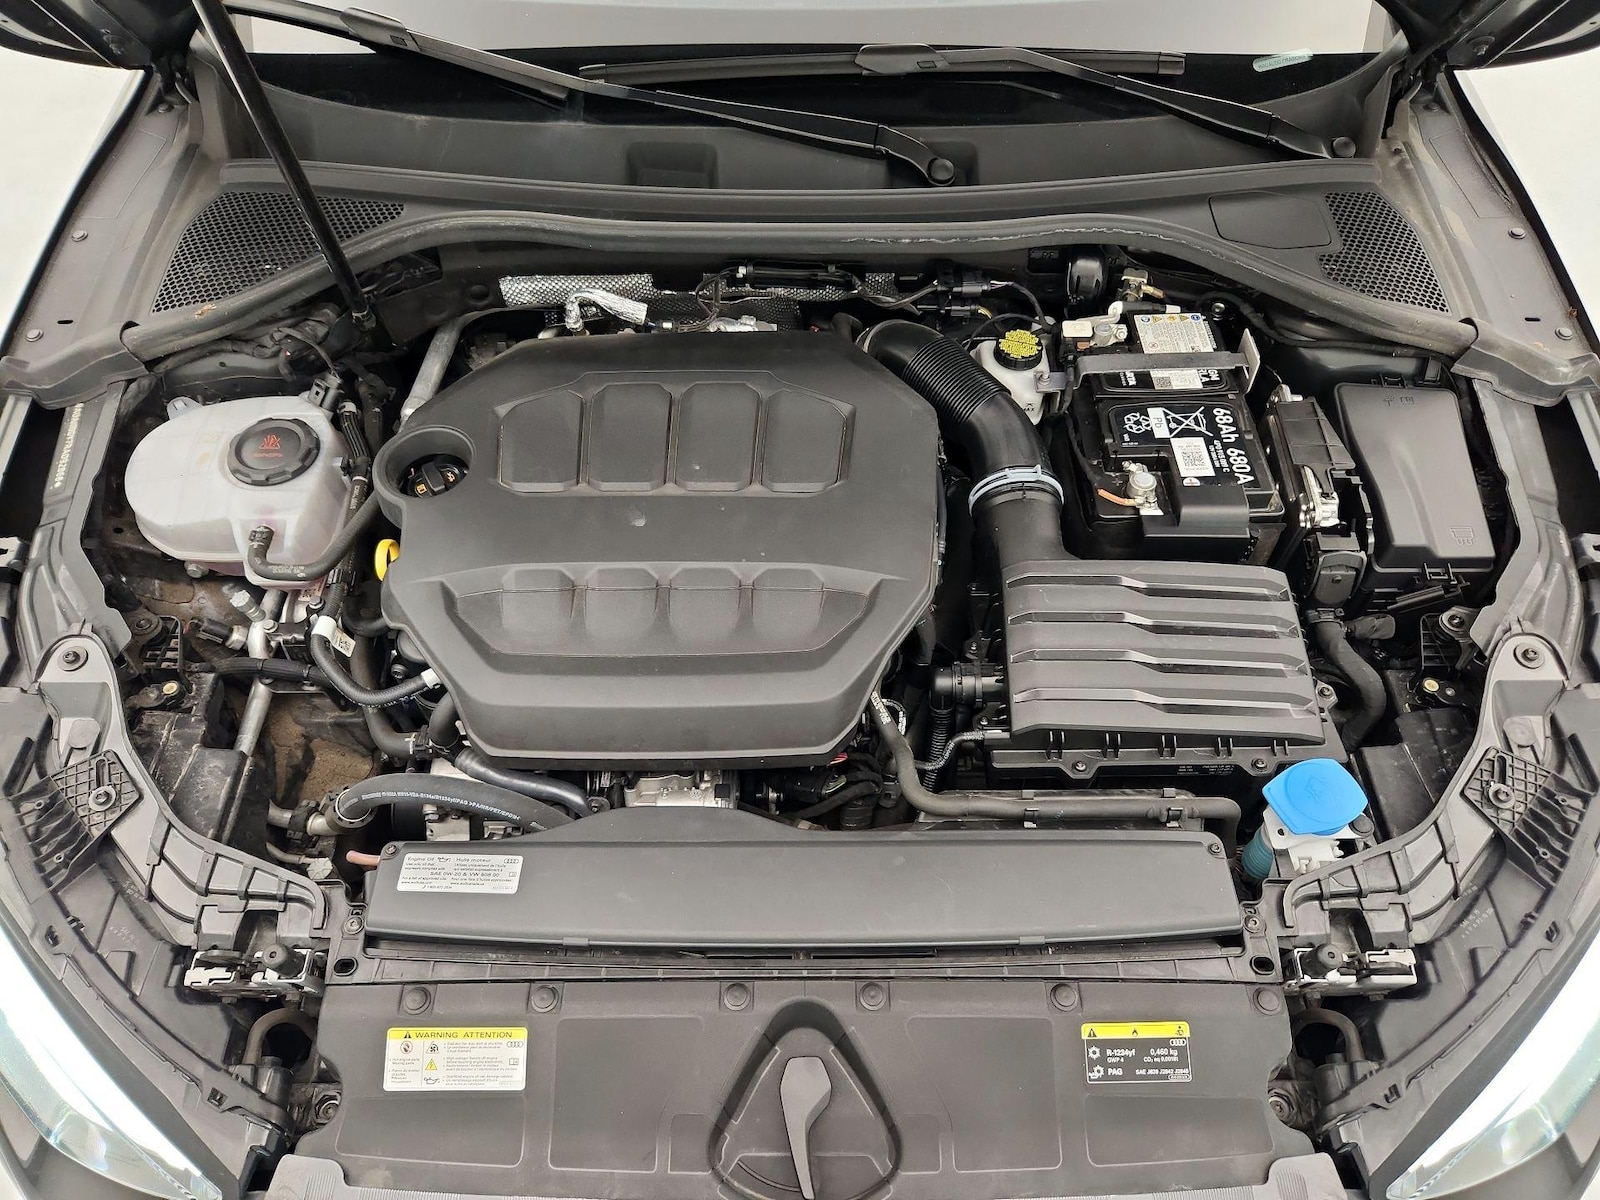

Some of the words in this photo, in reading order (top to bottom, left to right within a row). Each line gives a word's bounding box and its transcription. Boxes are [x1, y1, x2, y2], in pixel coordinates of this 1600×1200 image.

[1152, 417, 1164, 429] Pb
[1212, 407, 1239, 443] 68Ah
[1226, 447, 1255, 485] 680A
[1106, 1048, 1136, 1058] R-1234yf
[1169, 1048, 1179, 1058] kg
[1107, 1068, 1124, 1076] PAG
